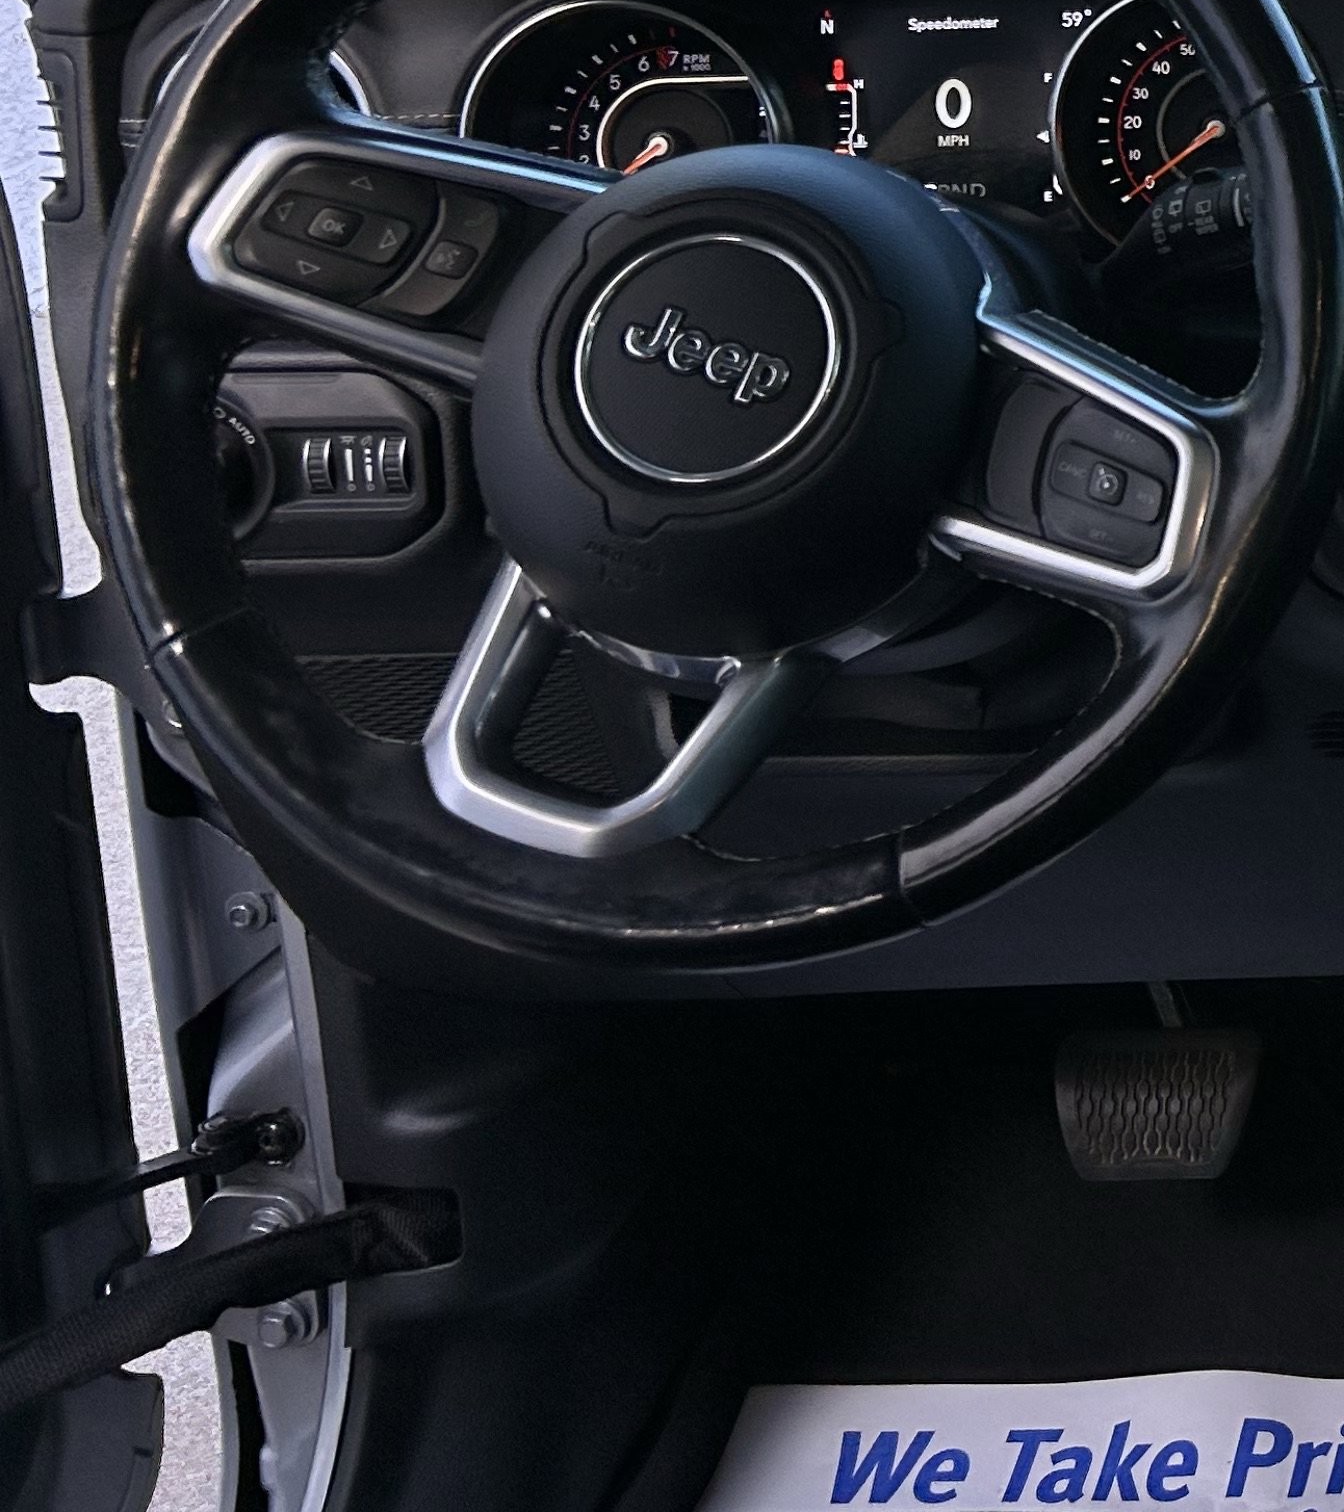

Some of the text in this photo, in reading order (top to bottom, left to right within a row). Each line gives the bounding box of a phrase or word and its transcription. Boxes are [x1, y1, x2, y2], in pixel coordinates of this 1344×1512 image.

[820, 18, 834, 35] N
[907, 16, 999, 33] Speedometer
[637, 55, 650, 72] 6
[668, 50, 680, 67] 7
[682, 53, 710, 64] RPM
[1151, 60, 1171, 75] 40
[609, 74, 621, 91] 5
[853, 78, 865, 89] H
[1043, 73, 1053, 83] F
[1132, 87, 1149, 100] 30
[588, 95, 601, 112] 4
[934, 77, 973, 130] 0
[1123, 115, 1143, 129] 20
[578, 124, 591, 142] 3
[937, 134, 970, 148] MPH
[1128, 149, 1141, 161] 10
[1043, 191, 1053, 202] E
[320, 219, 345, 236] OK
[623, 303, 792, 407] Jeep
[229, 416, 256, 446] AUTO
[828, 1429, 971, 1504] We
[1000, 1419, 1200, 1504] Take
